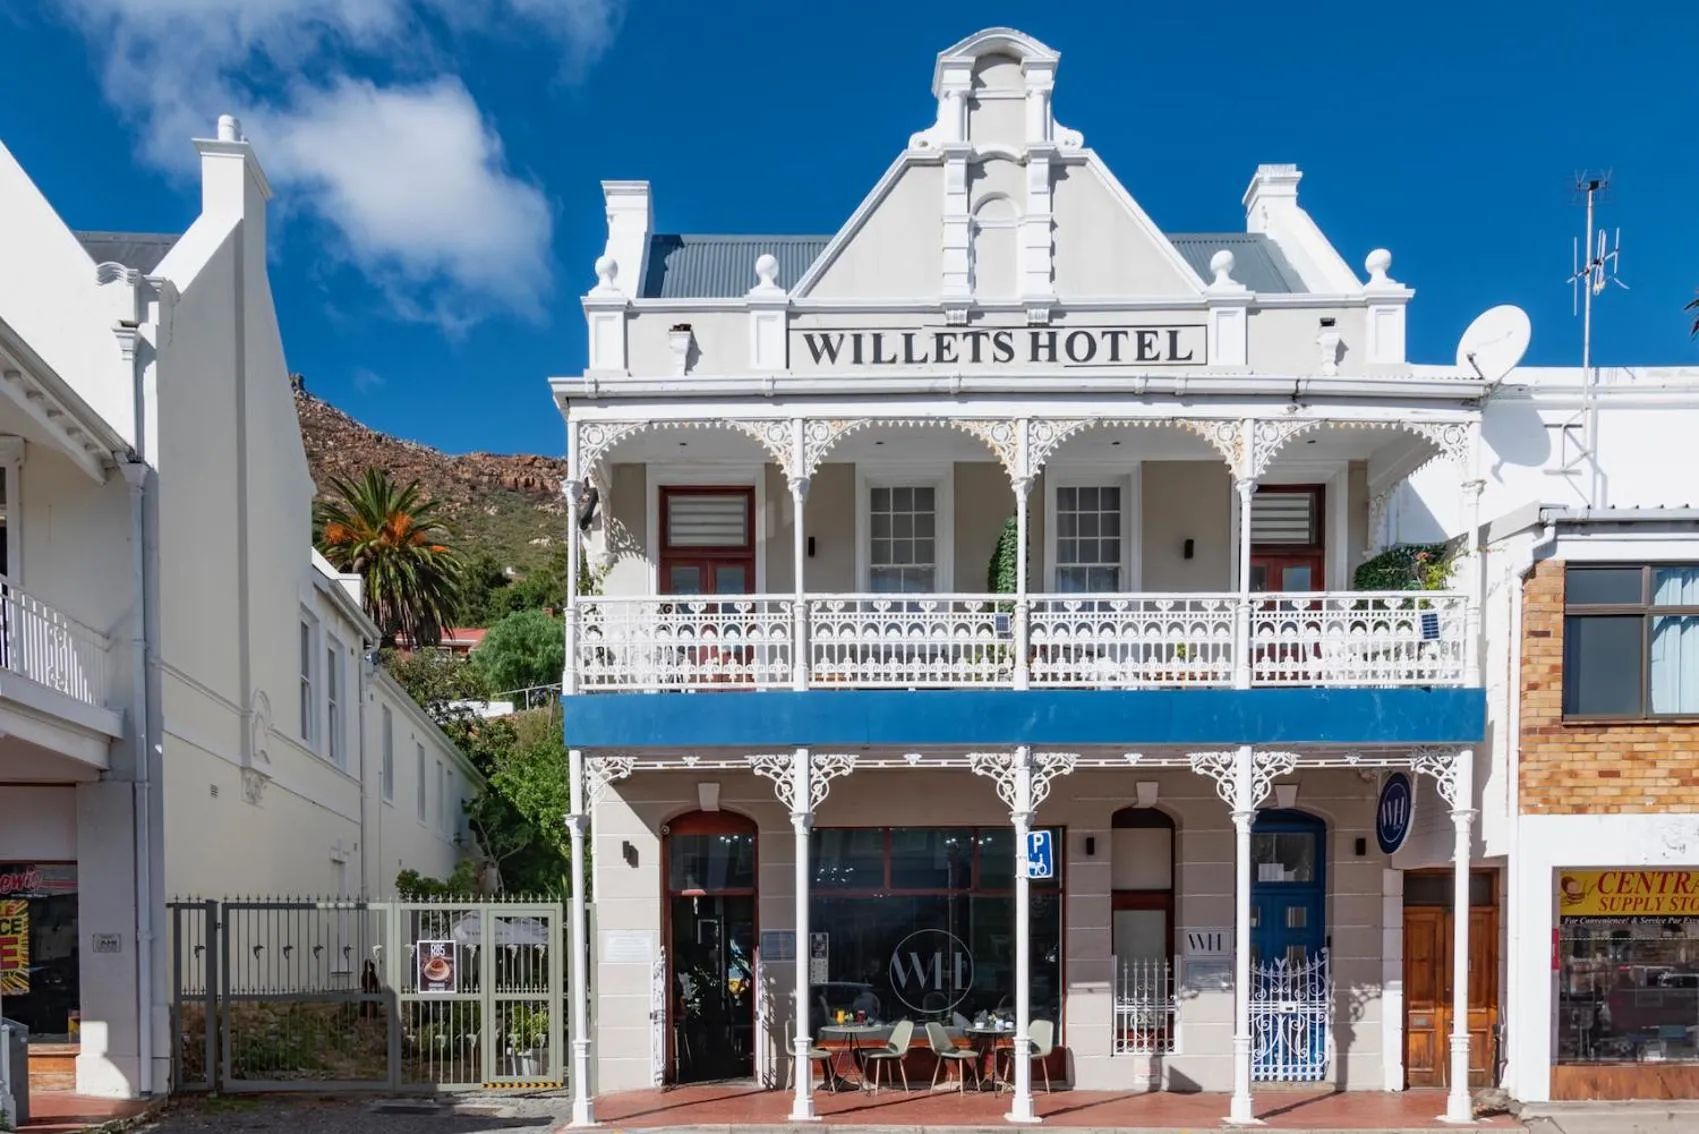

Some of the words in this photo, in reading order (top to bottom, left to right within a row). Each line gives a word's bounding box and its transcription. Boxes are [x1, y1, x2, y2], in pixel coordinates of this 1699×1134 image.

[803, 331, 1015, 365] WILLETS
[1029, 330, 1193, 363] HOTEL
[1033, 833, 1044, 853] P
[1598, 896, 1665, 911] SUPPLY
[1188, 933, 1221, 951] WH
